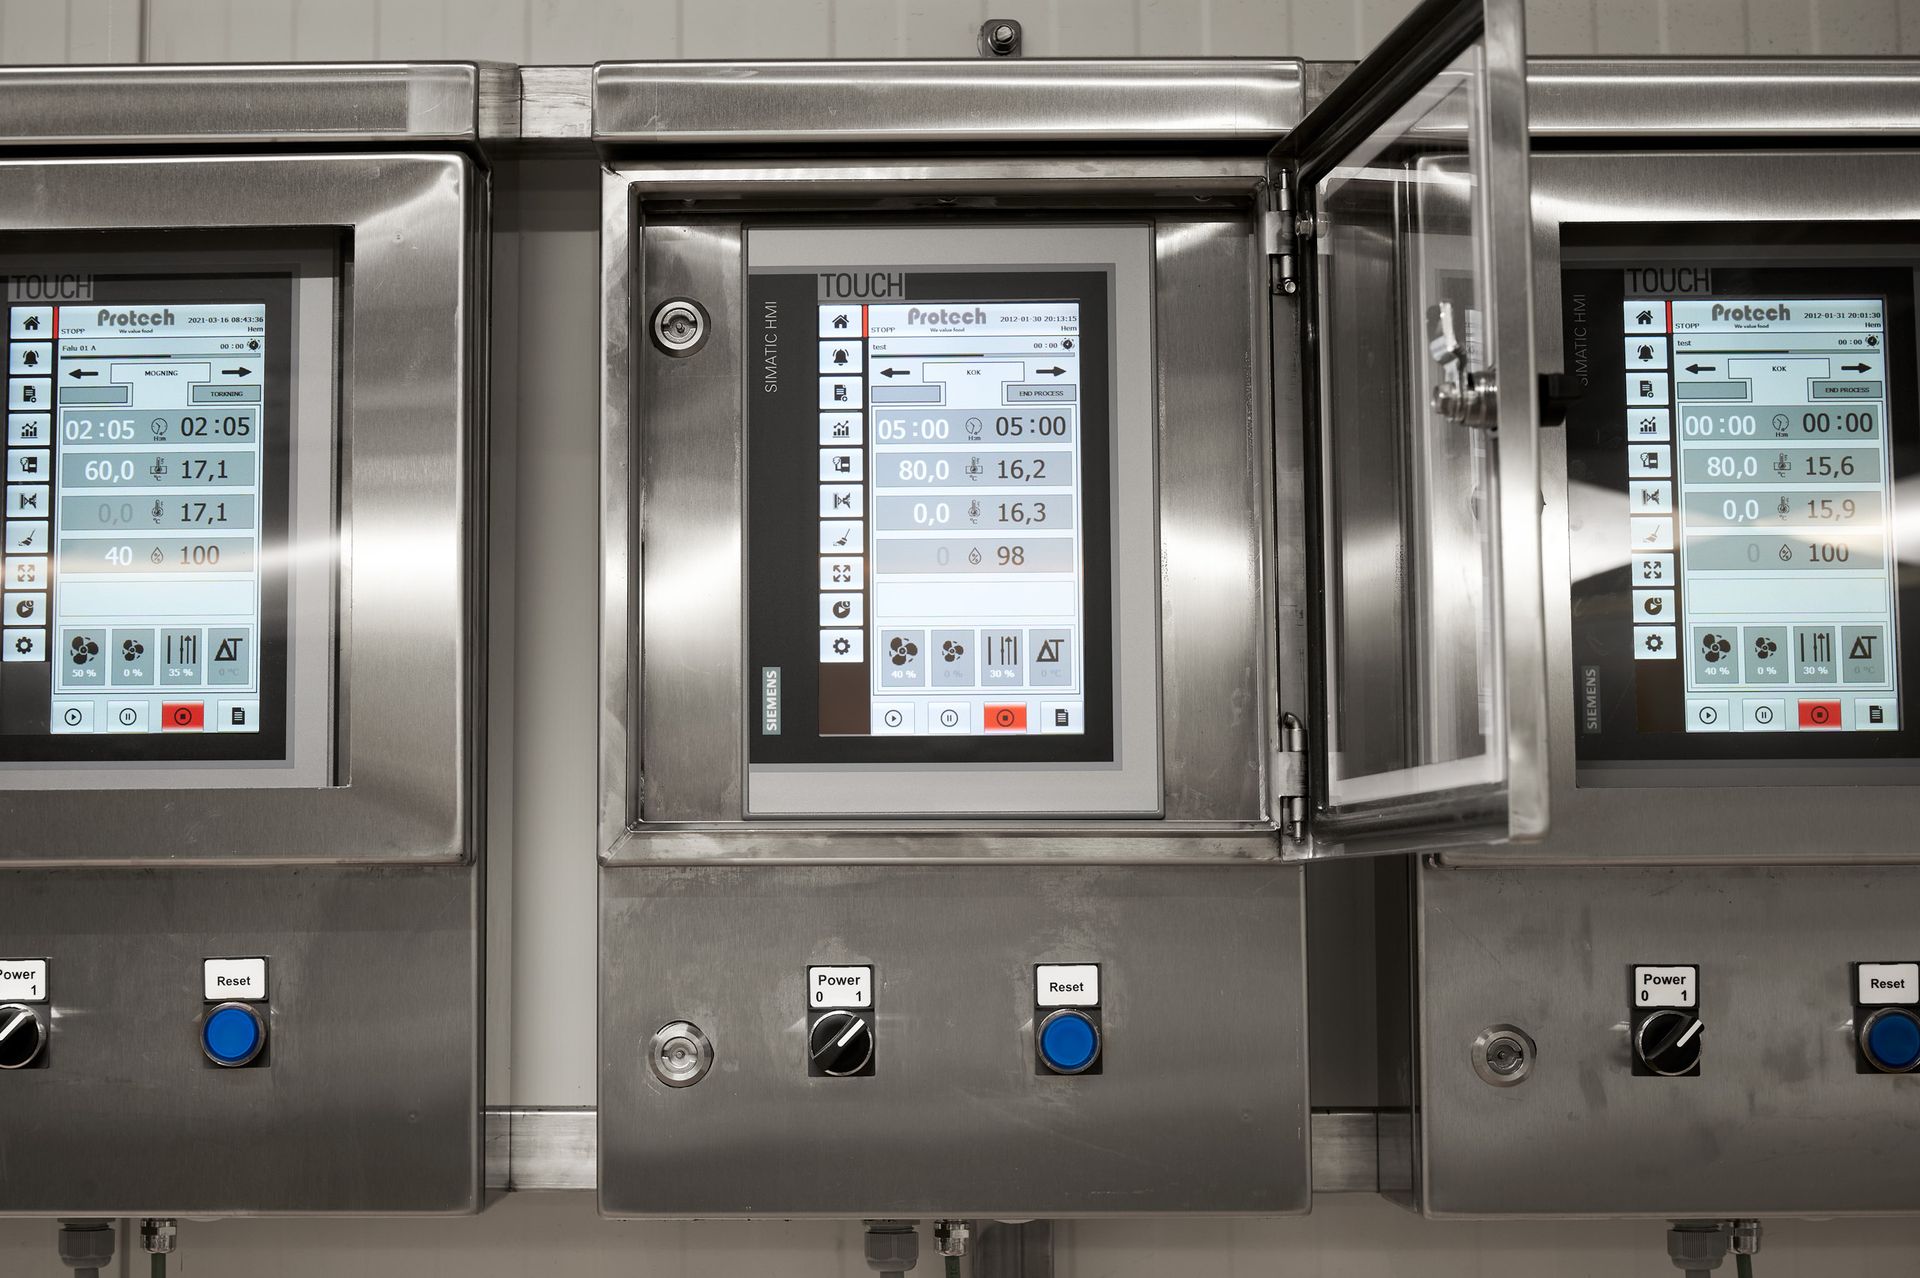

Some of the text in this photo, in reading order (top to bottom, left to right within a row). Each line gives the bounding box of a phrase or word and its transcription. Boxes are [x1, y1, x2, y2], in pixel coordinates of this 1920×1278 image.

[14, 274, 92, 299] TOUCH
[820, 272, 904, 298] TOUCH
[1627, 267, 1710, 293] TOUCH
[97, 308, 175, 327] Protech
[908, 308, 987, 326] Protech
[1573, 294, 1586, 322] HMI
[1712, 304, 1790, 322] Protech
[1000, 315, 1042, 323] 2012-01-30
[764, 302, 778, 393] SIMATIC HMI
[84, 460, 135, 484] 60,0
[182, 460, 228, 482] 17,1
[898, 460, 950, 484] 80,0
[998, 460, 1046, 482] 16,2
[1707, 456, 1758, 480] 80,0
[1806, 456, 1854, 479] 15,6
[98, 503, 134, 526] 0,0
[181, 502, 228, 525] 17,1
[913, 503, 950, 526] 0,0
[998, 502, 1046, 525] 16,3
[1722, 500, 1760, 522] 0,0
[1808, 499, 1856, 522] 15,9
[104, 546, 133, 566] 40
[180, 545, 220, 565] 100
[937, 546, 949, 566] 0
[997, 546, 1024, 566] 98
[1748, 544, 1760, 562] 0
[1809, 543, 1849, 562] 100
[72, 668, 96, 678] 50 %
[124, 668, 143, 677] 0 %
[168, 668, 194, 677] 35 %
[891, 670, 916, 678] 40 %
[990, 670, 1014, 678] 30 %
[1704, 667, 1730, 676] 40 %
[1757, 667, 1776, 675] 0 %
[1803, 666, 1828, 675] 30 %
[766, 670, 778, 732] SIEMENS
[1587, 668, 1598, 730] SIEMENS
[0, 969, 36, 980] ower
[217, 976, 251, 986] Reset
[818, 974, 861, 986] Power
[1644, 974, 1686, 986] Power
[1870, 978, 1905, 989] Reset
[30, 985, 37, 996] 1
[816, 991, 862, 1002] 0 1
[1050, 982, 1084, 992] Reset
[1640, 990, 1688, 1002] 0 1
